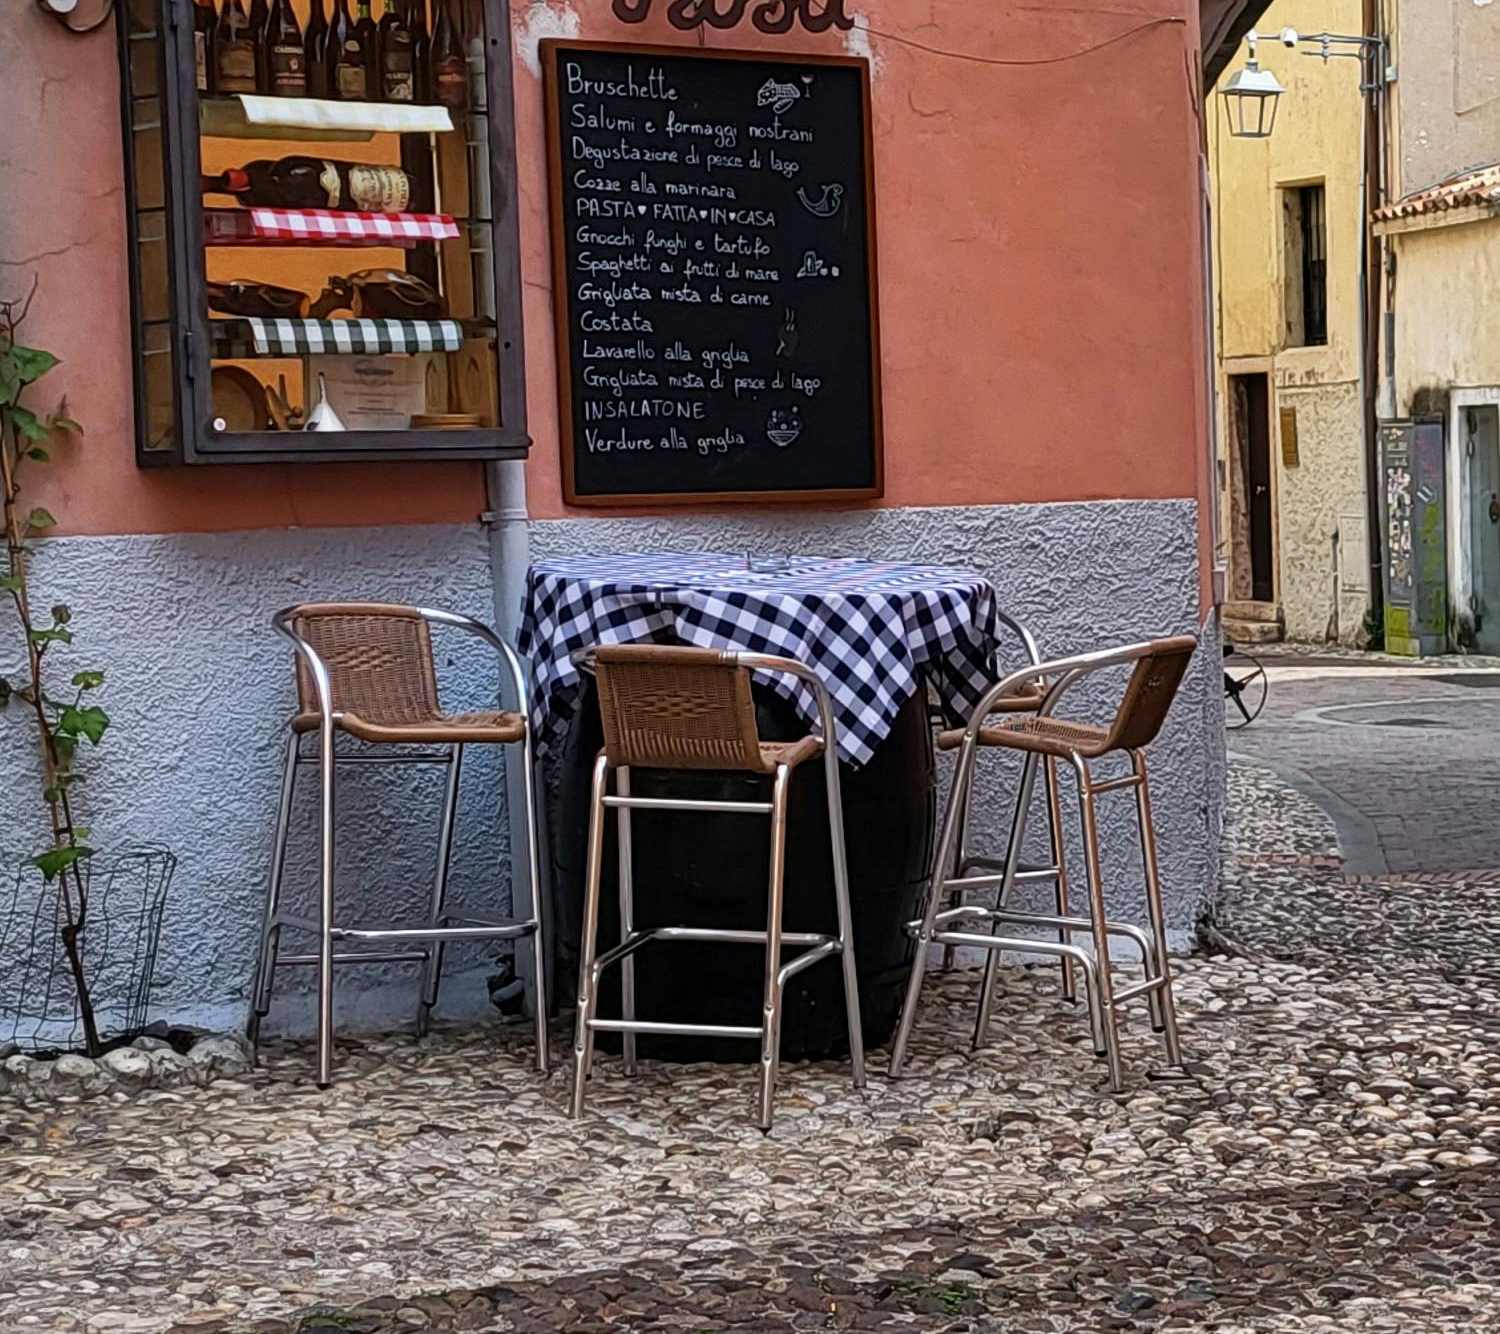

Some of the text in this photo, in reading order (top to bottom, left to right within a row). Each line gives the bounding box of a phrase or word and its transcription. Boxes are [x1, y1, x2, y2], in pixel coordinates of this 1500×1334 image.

[567, 63, 678, 101] Bruschette
[570, 104, 814, 147] Salumi e formaggi nostrani
[572, 136, 799, 178] Degustazione di pesce di lago
[574, 170, 735, 199] Cozze alla marinara
[577, 198, 775, 227] PASTA FATTA IN CASA
[577, 225, 770, 258] Gnocchi funghi e tartufo
[577, 252, 779, 281] Spaghetti ai frutti di mare
[578, 282, 652, 308] Grigliata
[661, 283, 701, 303] mista
[710, 286, 723, 303] di
[581, 311, 653, 332] Costata
[583, 340, 750, 369] Lavarello alla griglia
[584, 366, 820, 398] Grigliata mista di pesce di lago
[585, 400, 705, 421] INSALATONE
[585, 427, 744, 454] Verdure alla griglia
